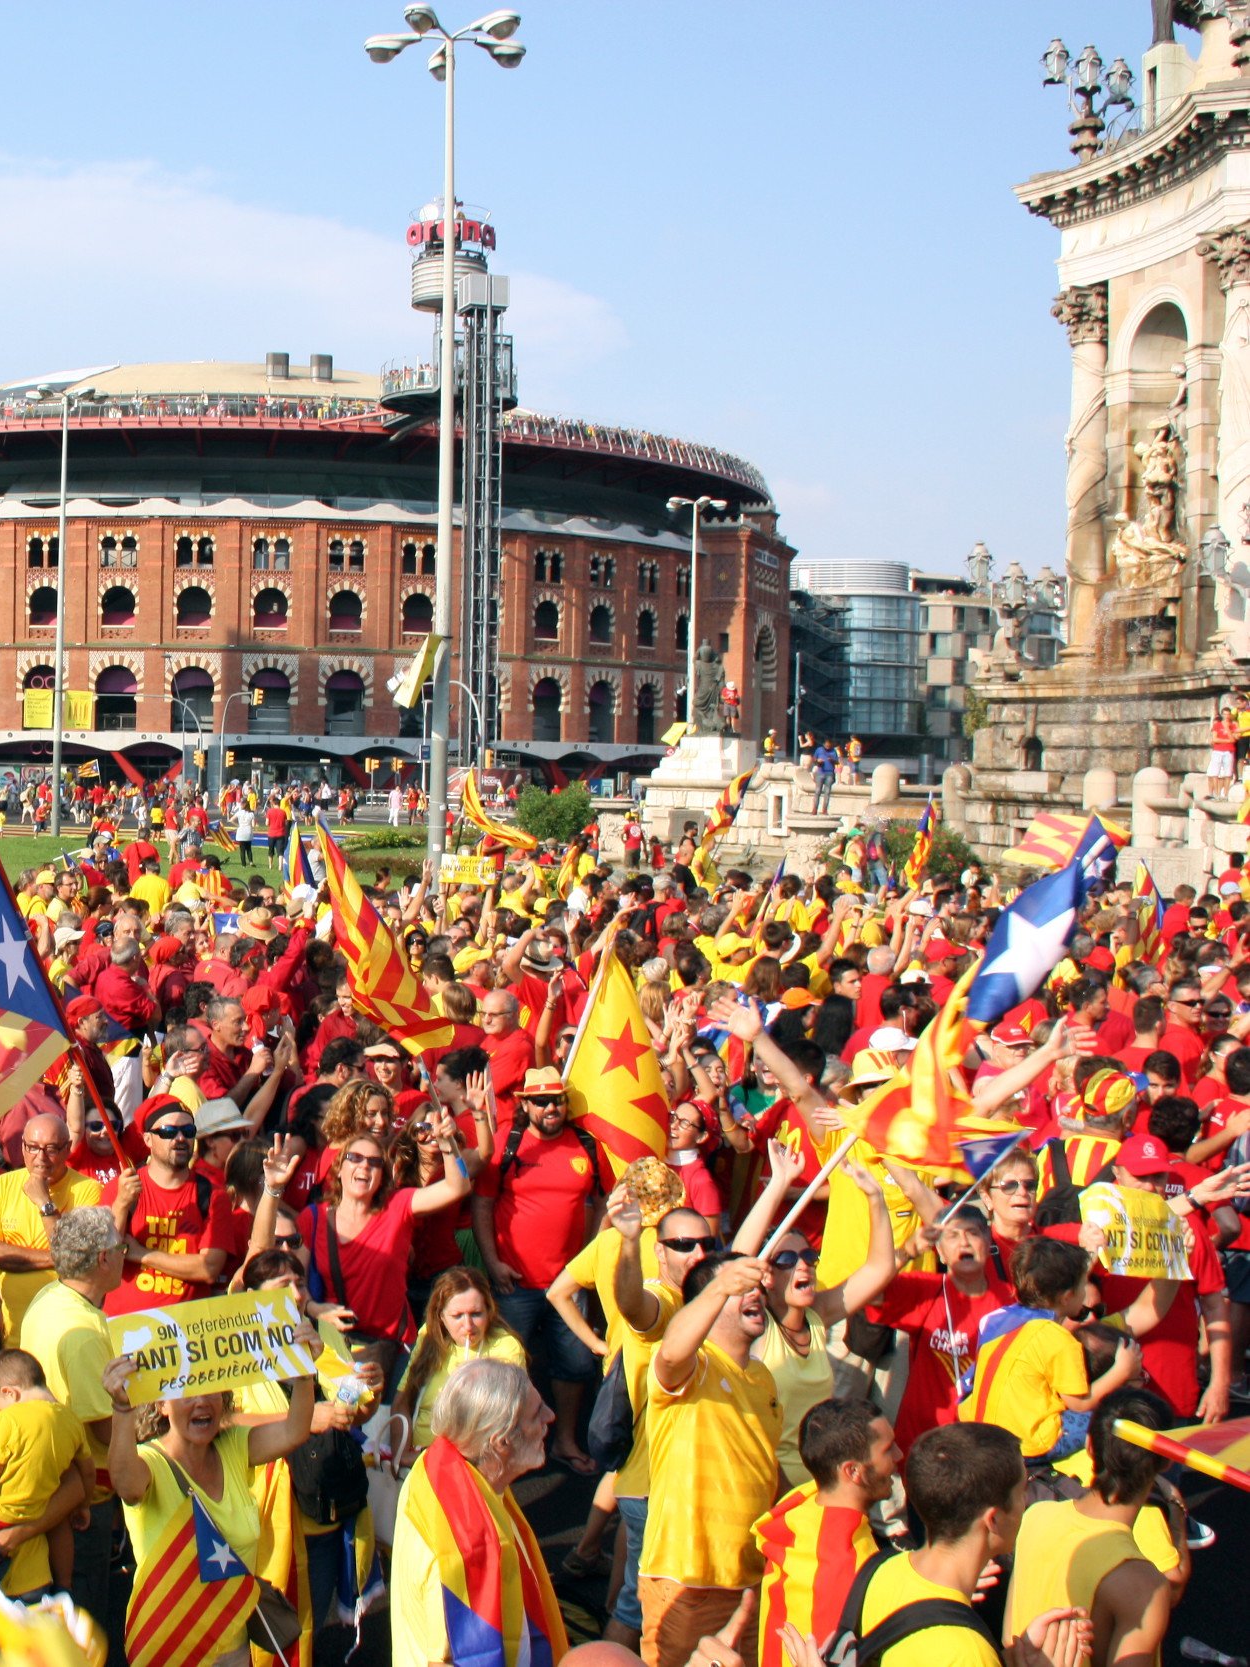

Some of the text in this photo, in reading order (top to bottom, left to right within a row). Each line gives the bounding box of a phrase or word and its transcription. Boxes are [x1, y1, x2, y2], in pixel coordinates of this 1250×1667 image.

[146, 1216, 177, 1236] TRI
[136, 1272, 185, 1295] ONS
[186, 1311, 264, 1336] referèndum
[186, 1334, 208, 1364] SÍ
[214, 1329, 263, 1356] COM
[268, 1322, 297, 1348] NO
[159, 1355, 279, 1391] DESOBEDIÈNCIA!
